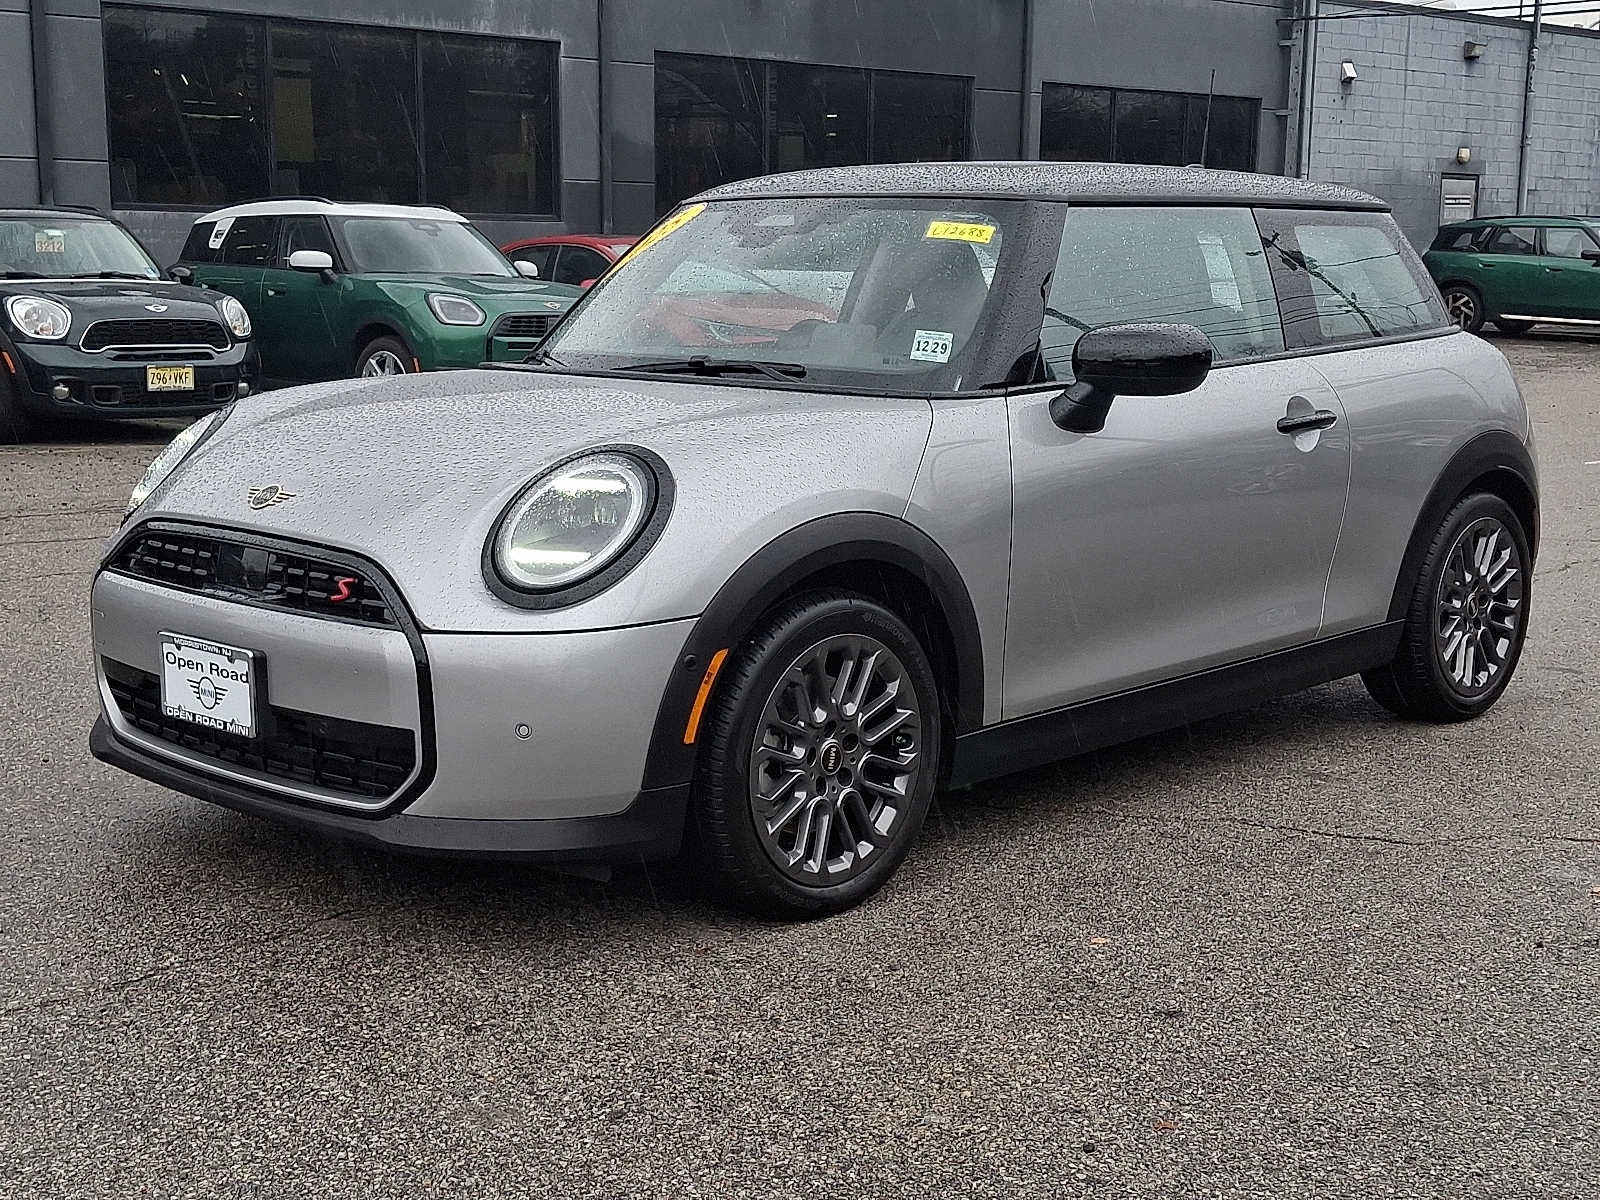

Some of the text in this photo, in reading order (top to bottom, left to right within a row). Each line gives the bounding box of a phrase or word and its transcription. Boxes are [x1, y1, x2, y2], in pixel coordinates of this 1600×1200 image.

[330, 577, 355, 601] S
[165, 651, 249, 684] Open Road
[200, 687, 215, 699] MINI
[166, 707, 249, 737] OPEN ROAD MINI
[827, 747, 837, 770] MINI
